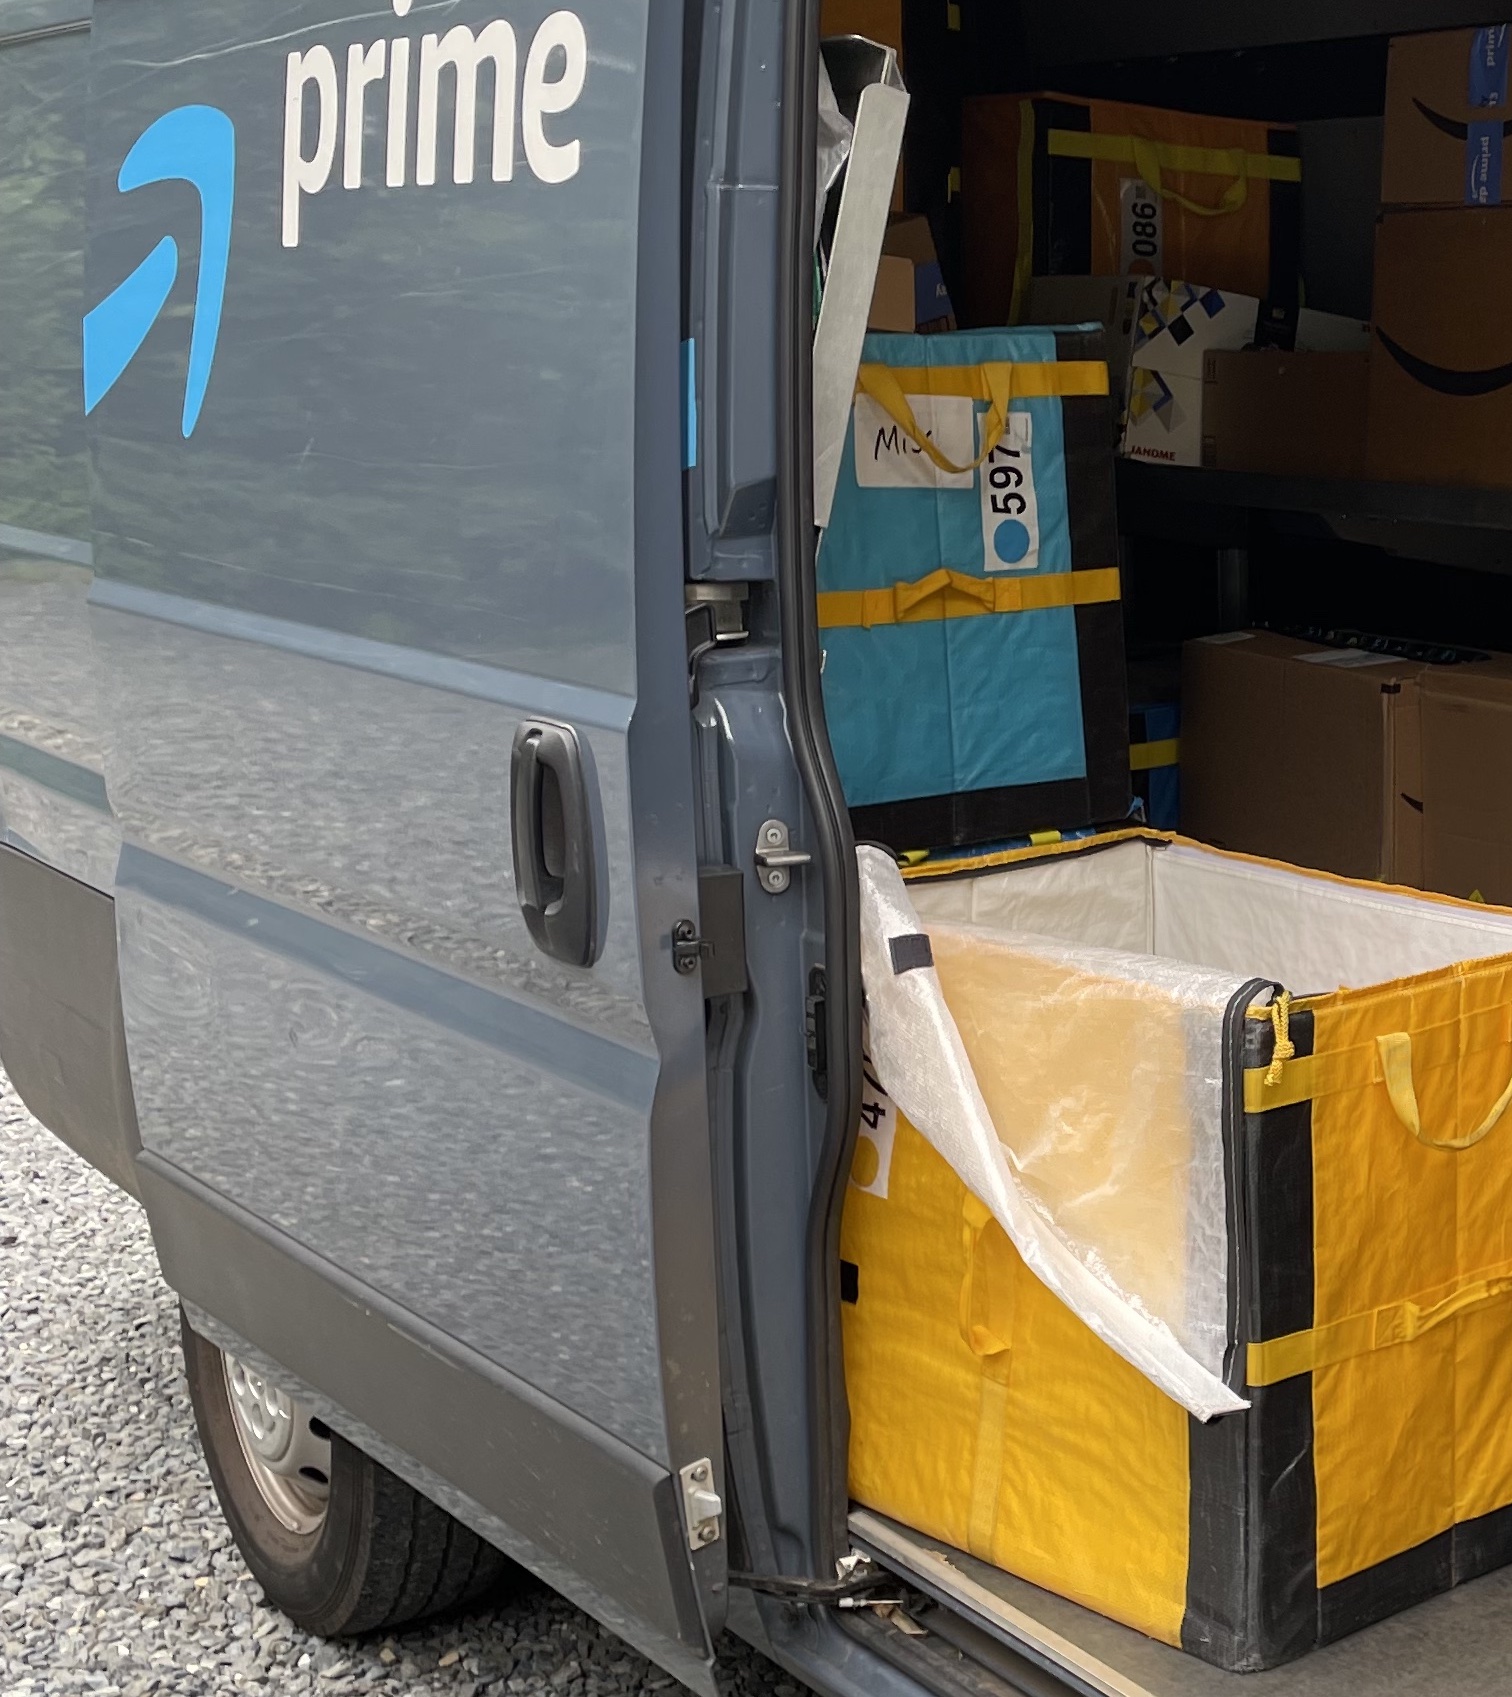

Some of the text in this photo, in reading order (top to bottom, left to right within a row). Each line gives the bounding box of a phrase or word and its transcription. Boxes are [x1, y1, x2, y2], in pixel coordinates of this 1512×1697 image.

[1486, 26, 1497, 67] prim
[281, 0, 588, 248] prime
[1480, 136, 1491, 182] prime
[1132, 203, 1157, 257] 086
[988, 444, 1026, 514] 597
